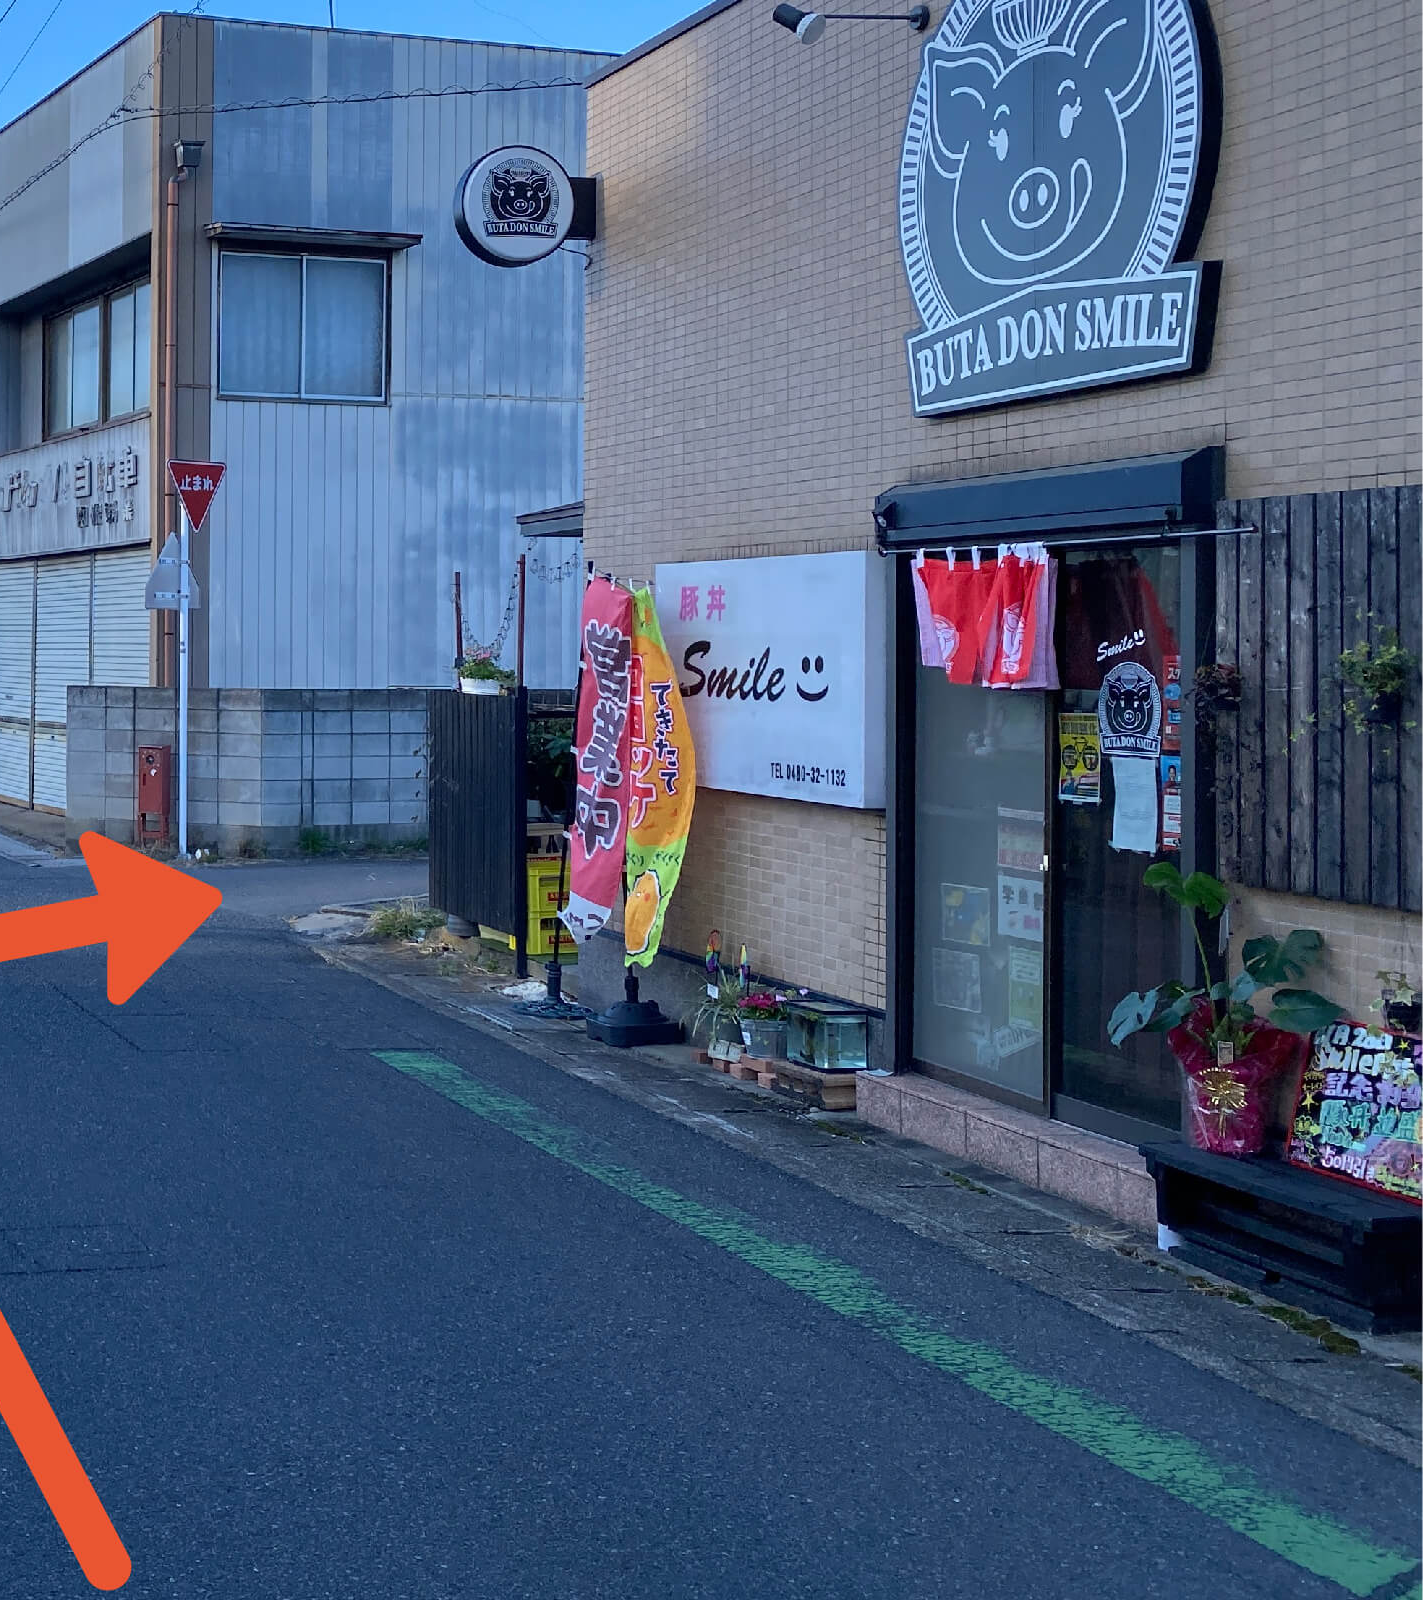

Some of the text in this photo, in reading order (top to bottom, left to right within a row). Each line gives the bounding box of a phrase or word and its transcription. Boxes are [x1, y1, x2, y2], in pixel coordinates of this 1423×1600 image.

[487, 222, 555, 235] BUTA DON SMILE
[916, 292, 1183, 396] BUTA DON SMILE
[179, 474, 214, 492] 止まれ
[679, 585, 726, 621] 豚丼
[1097, 635, 1134, 662] Smile
[680, 640, 786, 702] Smile
[1124, 736, 1137, 748] DON
[770, 762, 846, 787] TEL 0480-32-1132
